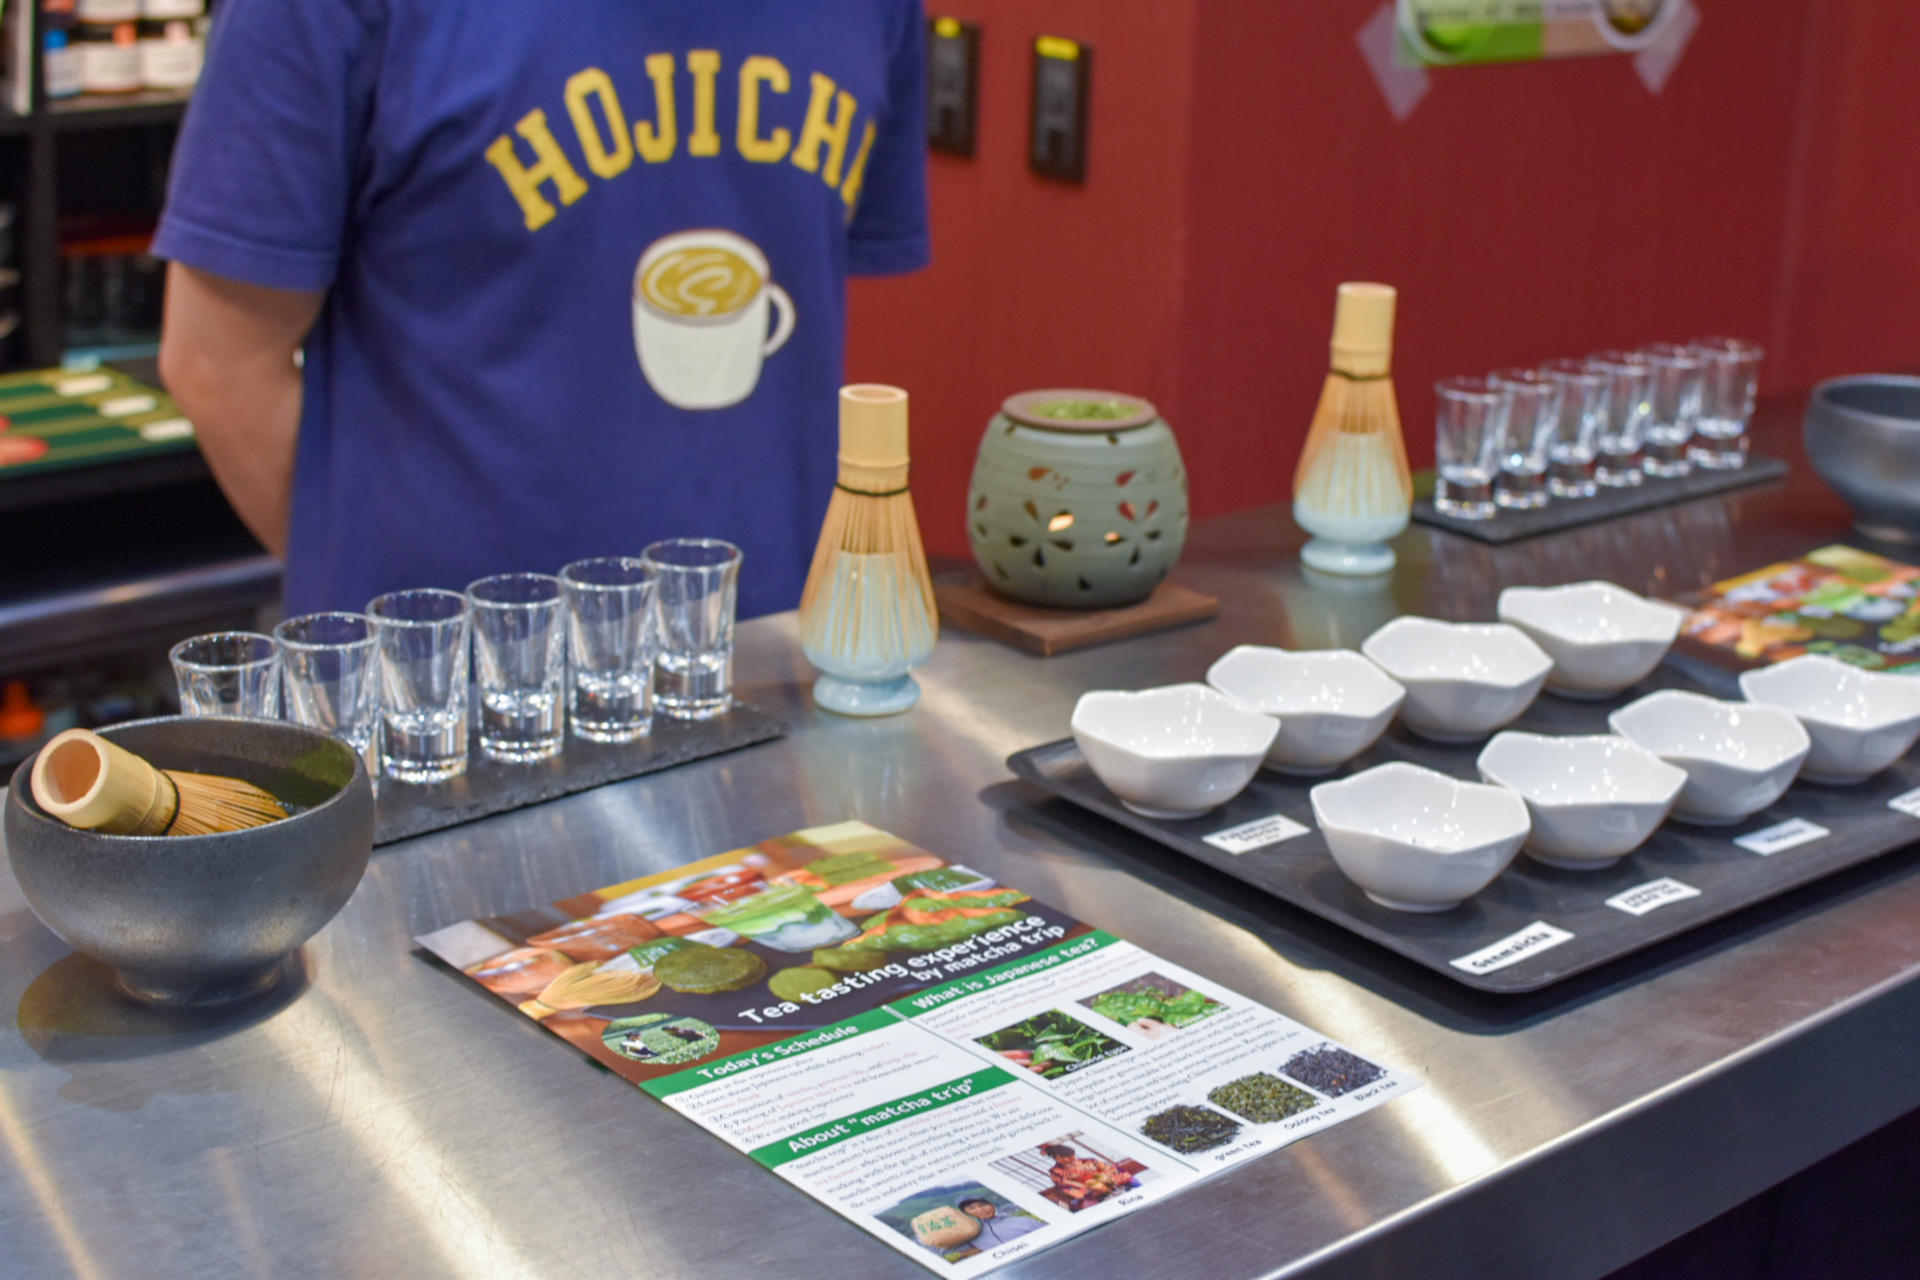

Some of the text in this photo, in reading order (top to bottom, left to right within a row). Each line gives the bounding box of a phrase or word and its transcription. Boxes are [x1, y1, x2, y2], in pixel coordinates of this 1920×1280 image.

[738, 1001, 800, 1023] Tea
[800, 962, 909, 1004] tasting
[908, 916, 1046, 967] experience
[910, 925, 1066, 981] by matcha trip
[912, 985, 965, 1009] What
[962, 981, 984, 992] is
[985, 954, 1061, 985] Japanese
[1060, 938, 1099, 958] tea?
[1471, 931, 1551, 967] Genmaicha
[697, 1025, 859, 1079] Today's Schedule
[788, 1123, 850, 1153] About
